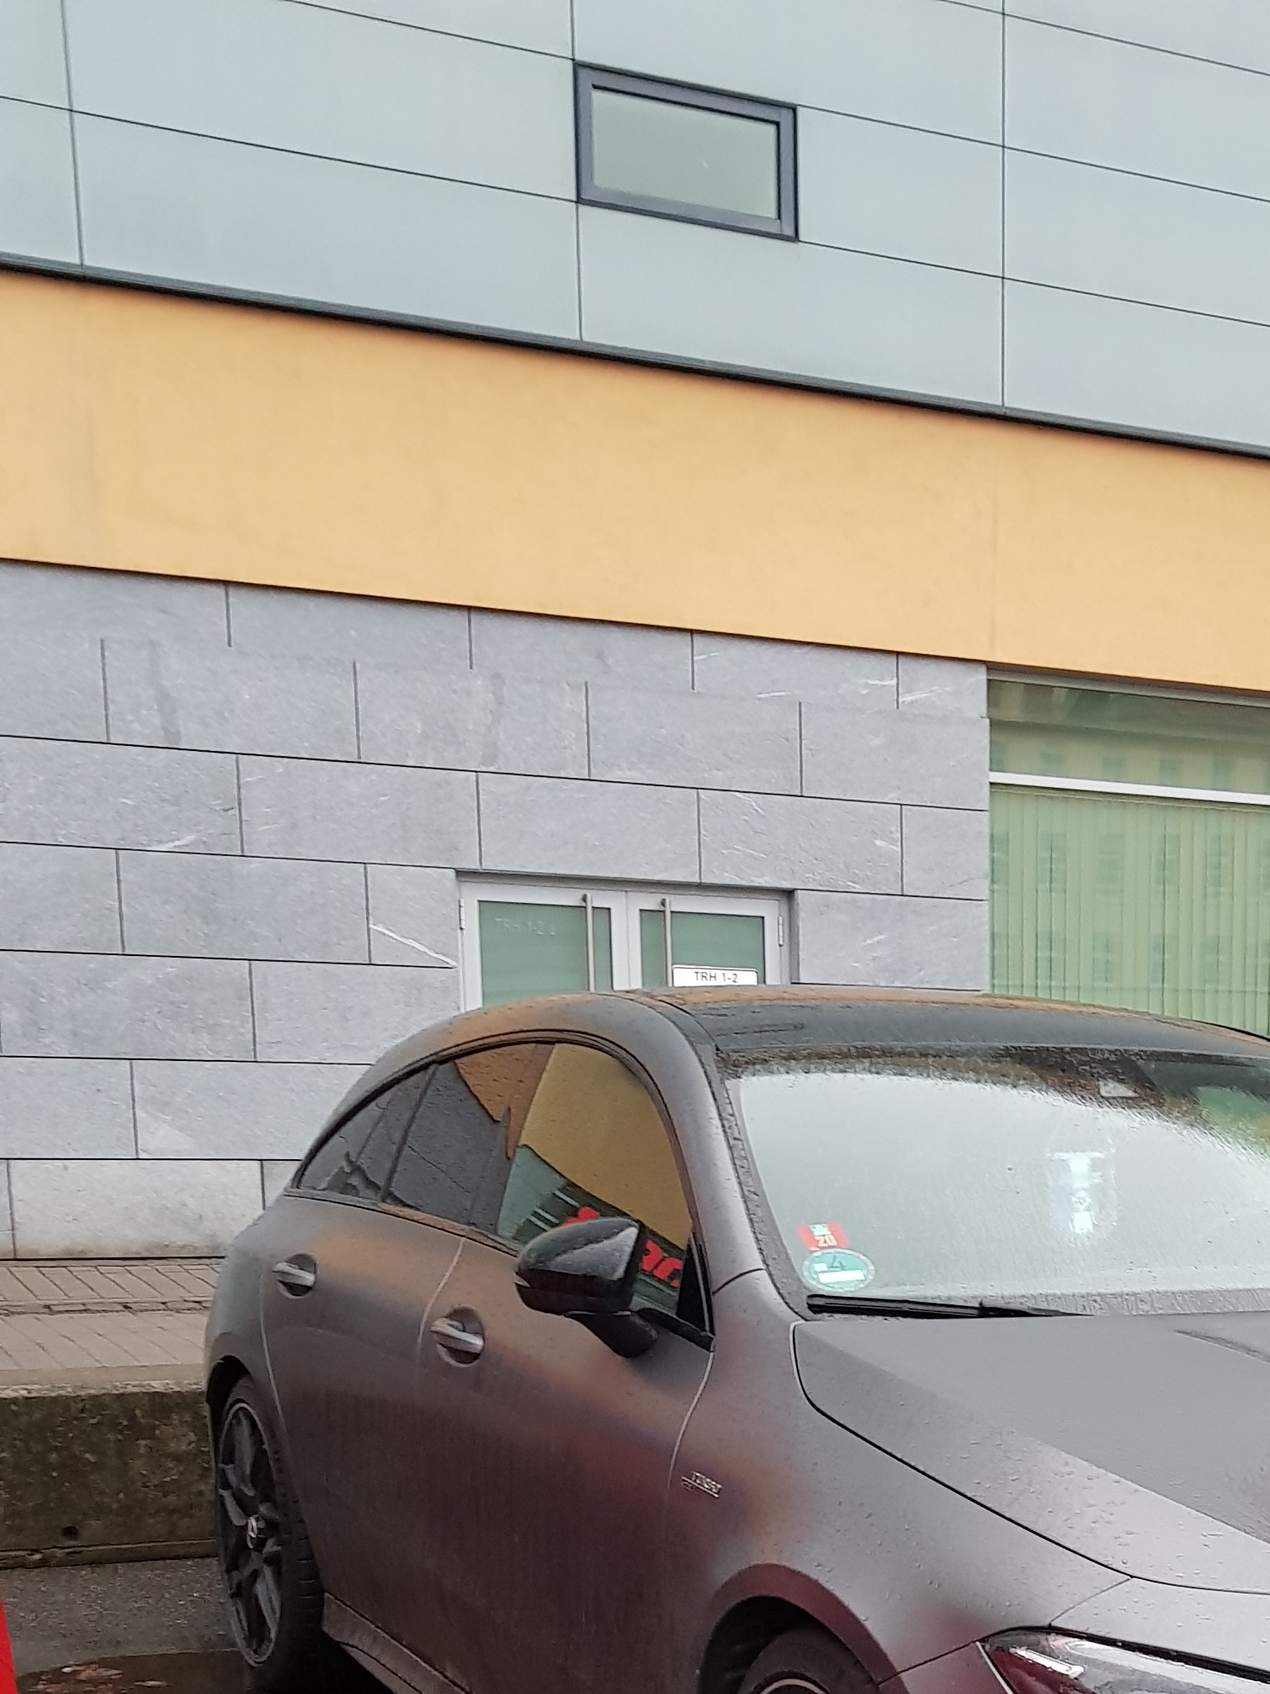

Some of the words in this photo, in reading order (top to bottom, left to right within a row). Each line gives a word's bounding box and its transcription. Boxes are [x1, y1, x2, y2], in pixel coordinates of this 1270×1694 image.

[694, 971, 717, 982] TRH
[722, 972, 738, 984] 1-2
[814, 1234, 838, 1248] 20
